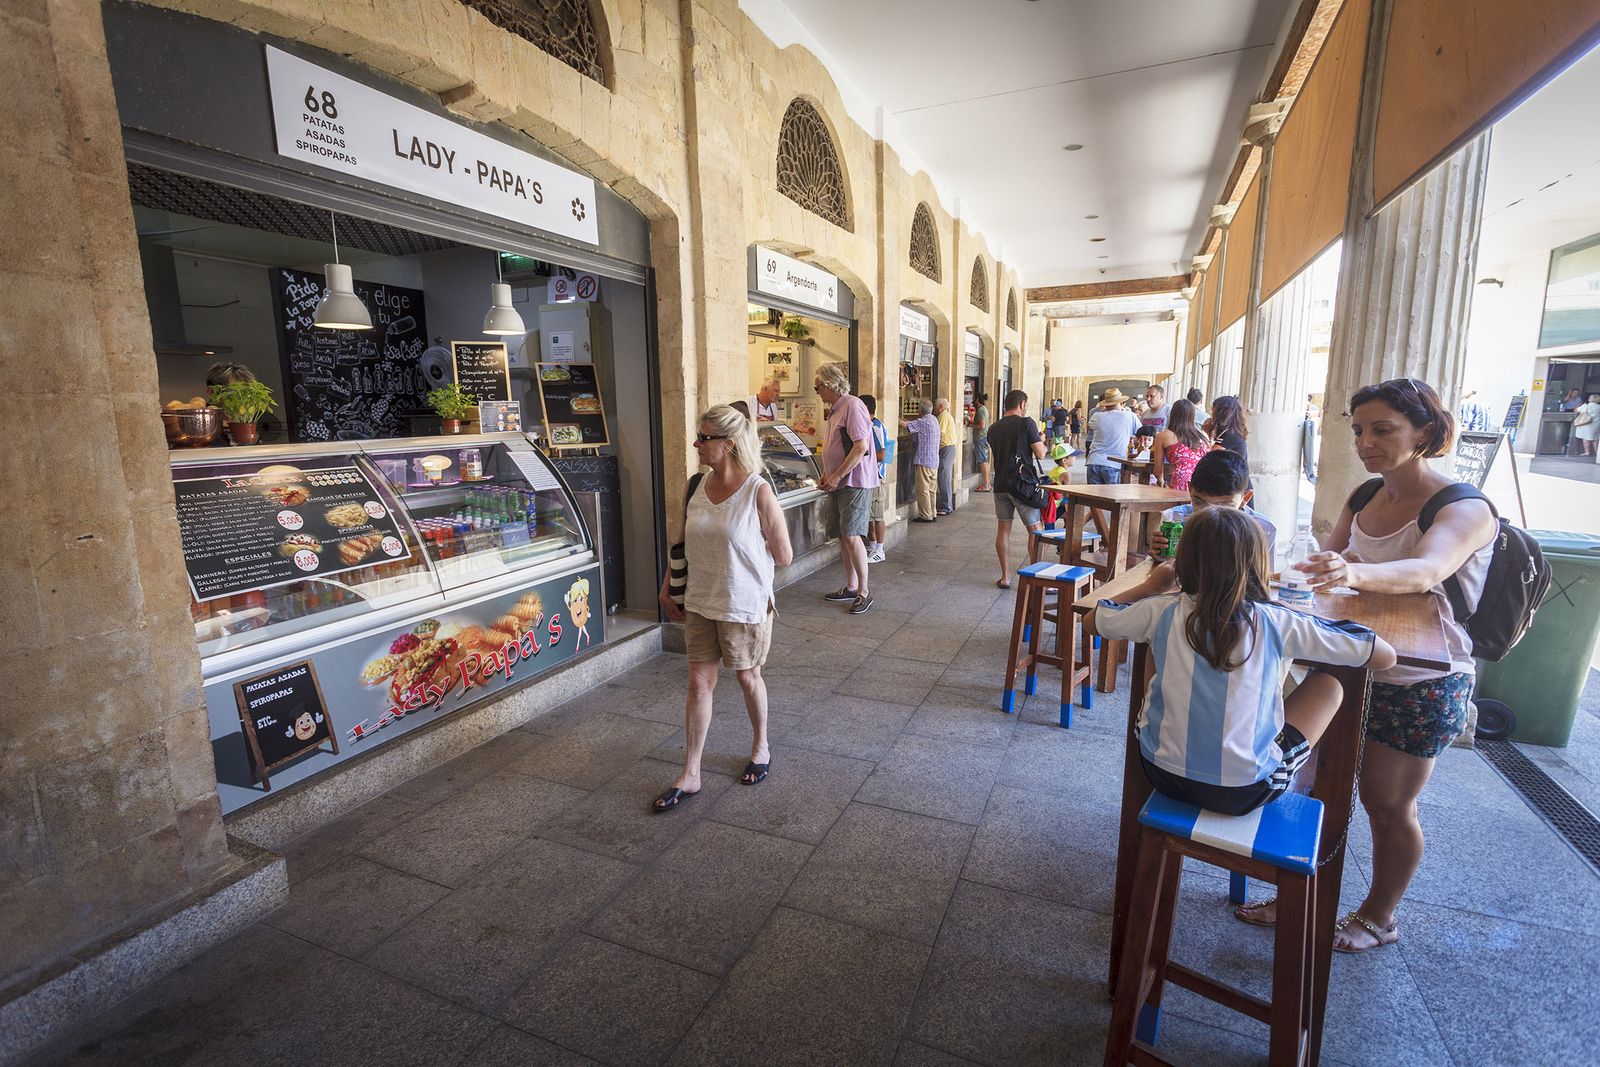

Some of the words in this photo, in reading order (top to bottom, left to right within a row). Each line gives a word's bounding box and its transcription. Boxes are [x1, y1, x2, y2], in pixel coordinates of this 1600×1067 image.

[304, 85, 338, 119] 68
[302, 113, 345, 135] PATATAS
[306, 128, 346, 148] ASADAS
[296, 140, 357, 166] SPIROPAPAS
[392, 128, 456, 174] LADY
[766, 258, 777, 274] 69
[286, 277, 319, 302] Pide
[286, 306, 300, 317] la
[300, 294, 320, 310] Papa
[374, 286, 410, 316] elige
[378, 308, 390, 324] tu
[180, 492, 216, 500] PATATAS
[365, 505, 385, 515] 2,50€
[279, 514, 303, 526] 5,00€
[382, 540, 401, 552] 2,00€
[186, 552, 214, 560] ALIÑADA:
[224, 552, 272, 564] ESPECIALES
[296, 554, 318, 568] 8,00€
[194, 570, 228, 580] MARINERA:
[196, 578, 227, 586] GALLEGA:
[199, 584, 223, 592] CARNE:
[246, 676, 276, 693] PATATAS
[278, 667, 307, 684] ASADAS
[250, 687, 293, 709] SPIROPAPAS
[349, 675, 450, 739] Lady
